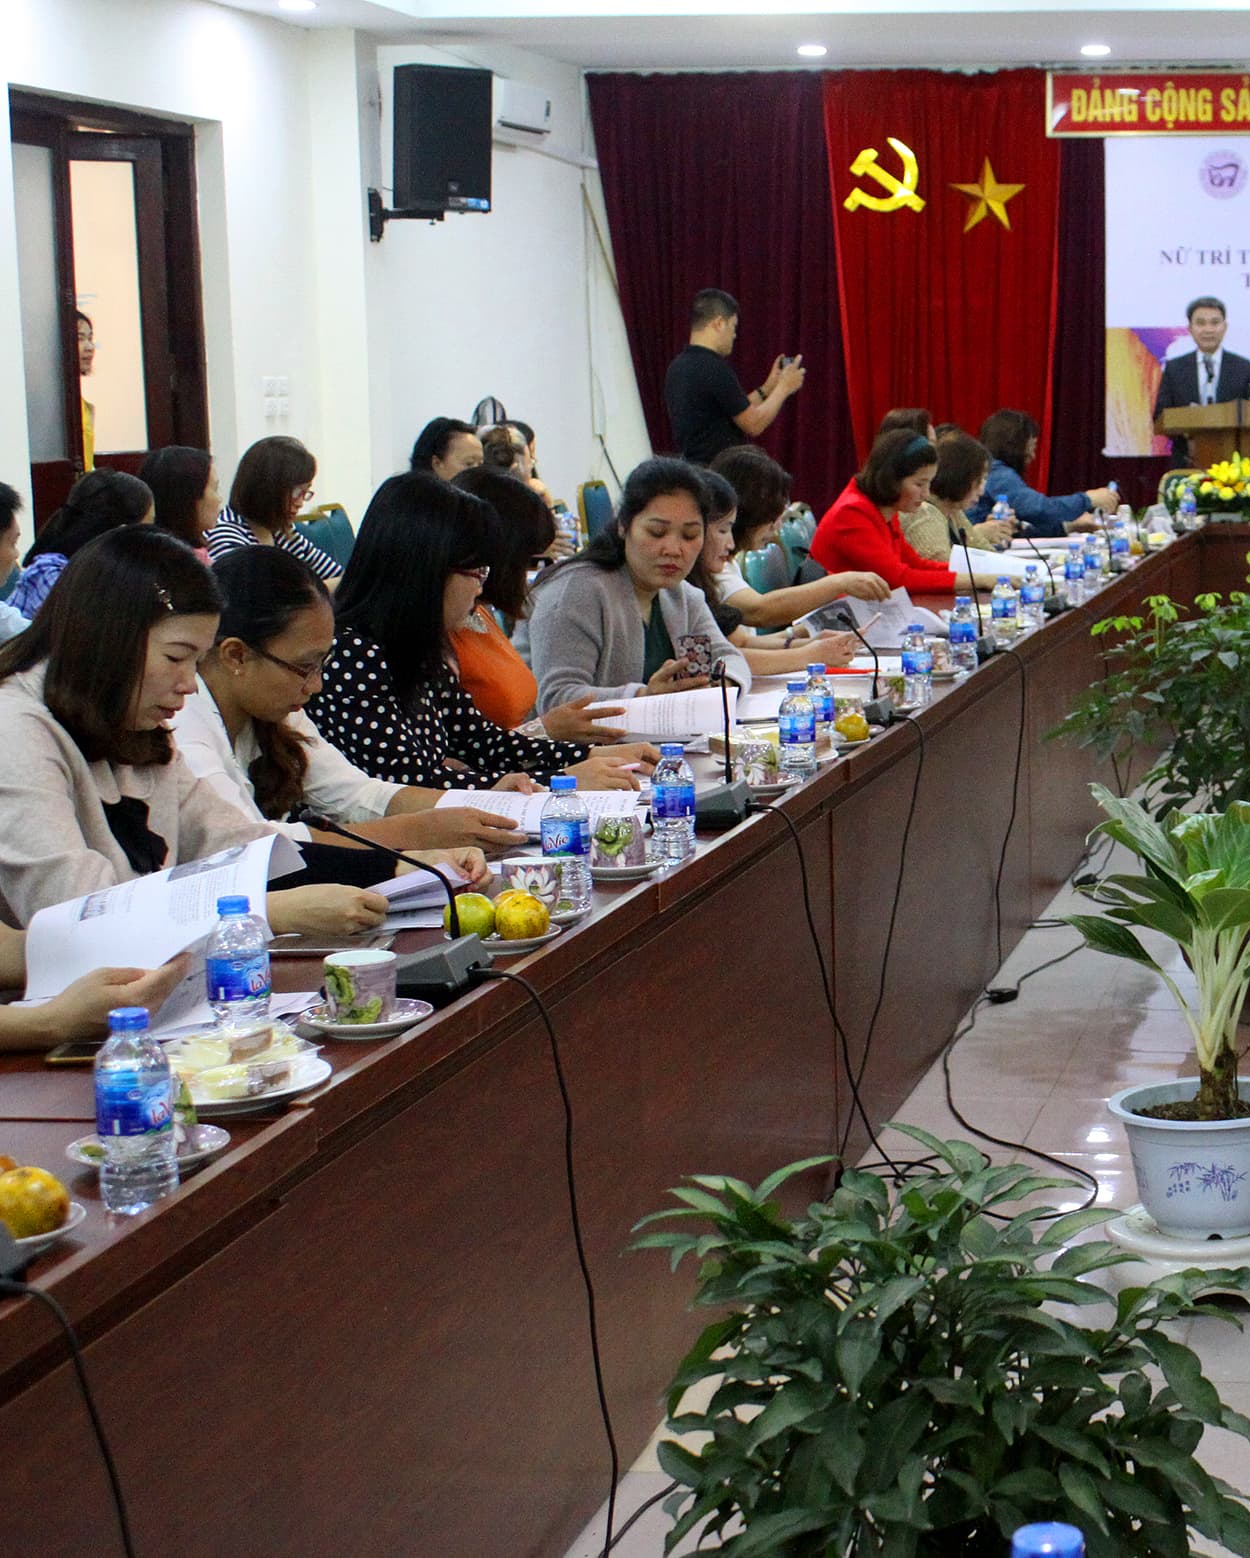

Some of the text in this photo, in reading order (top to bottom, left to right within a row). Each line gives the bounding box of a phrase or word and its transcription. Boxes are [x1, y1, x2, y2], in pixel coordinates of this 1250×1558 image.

[1070, 77, 1138, 122] ĐẢNG
[1145, 81, 1212, 128] CỘNG
[1160, 245, 1192, 265] NỮ
[1196, 244, 1232, 265] TRÍ
